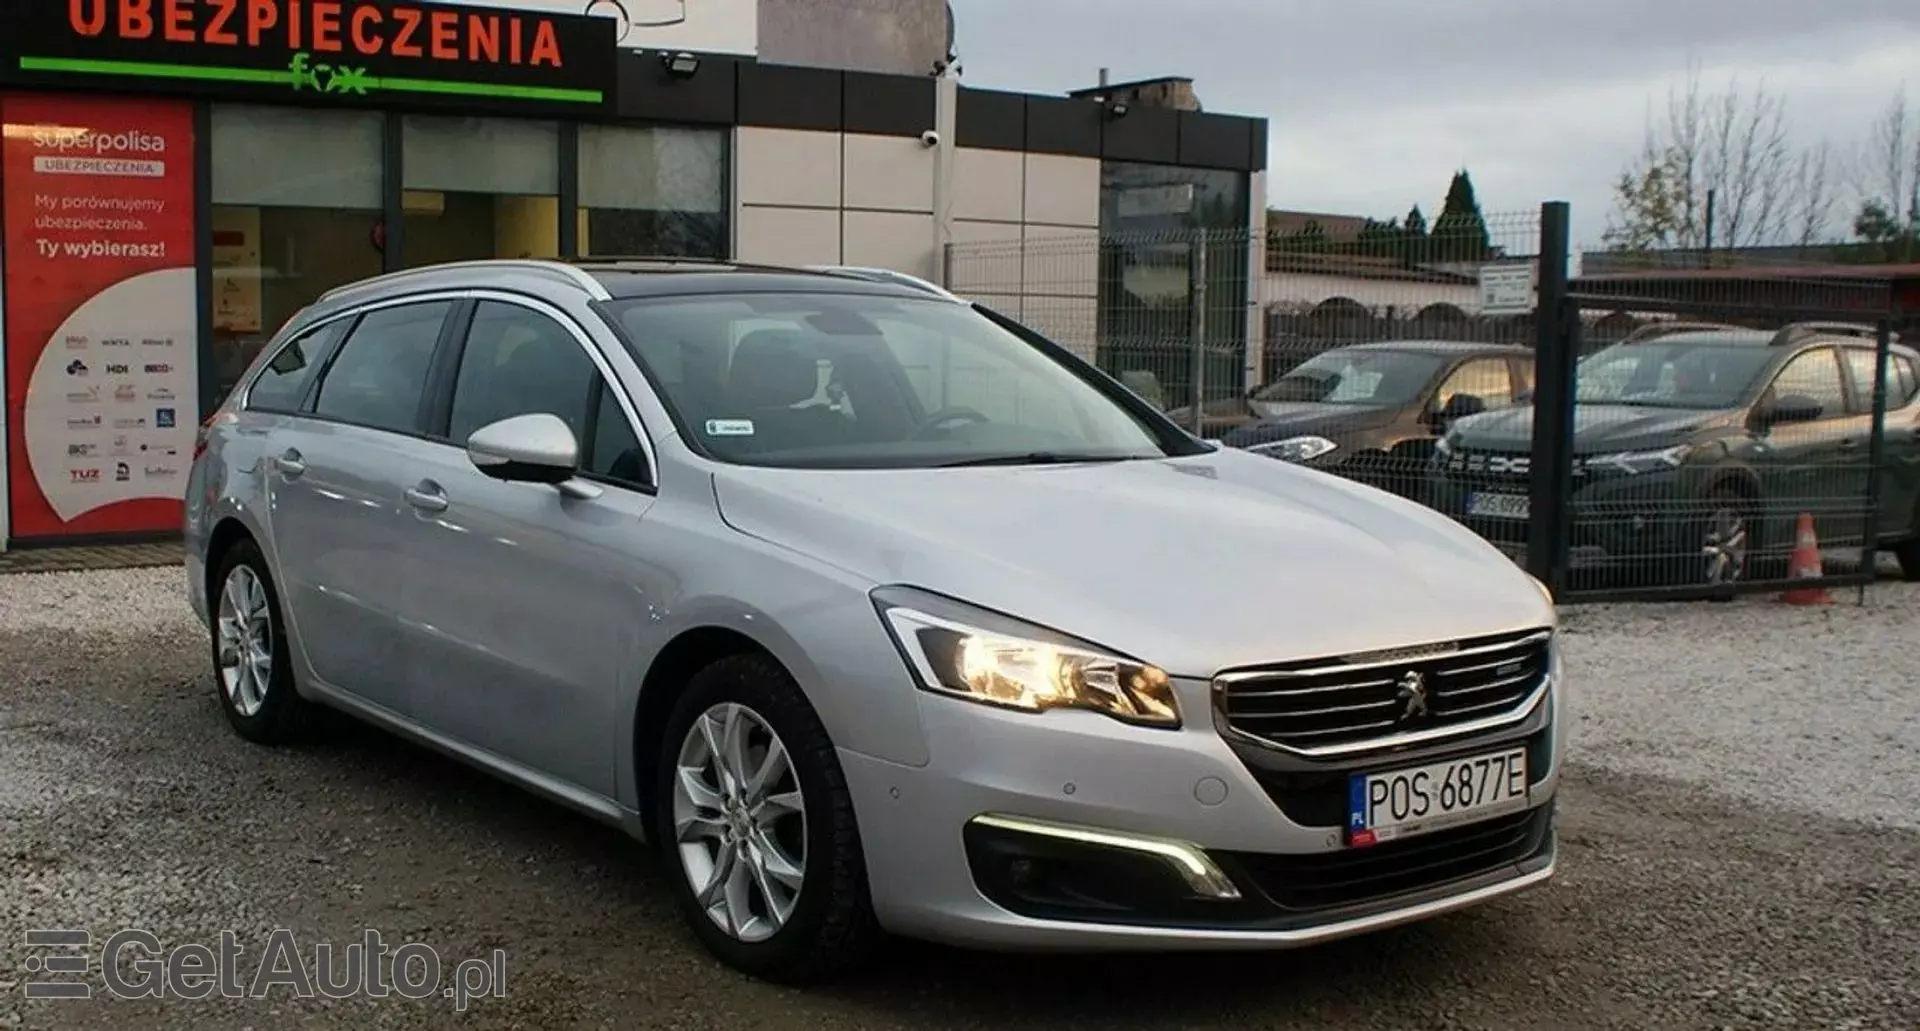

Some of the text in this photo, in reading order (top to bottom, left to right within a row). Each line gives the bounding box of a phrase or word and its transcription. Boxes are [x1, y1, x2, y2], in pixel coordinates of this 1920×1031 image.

[69, 0, 563, 67] UBEZPIECZENIA
[33, 129, 165, 154] superpolisa
[44, 158, 155, 174] UBEZPIECZENIA
[35, 194, 58, 210] My
[35, 215, 147, 231] ubezpieczenia.
[36, 238, 165, 259] Ty wybierasz!
[69, 467, 101, 479] TUZ
[1368, 751, 1524, 826] POS 6877E
